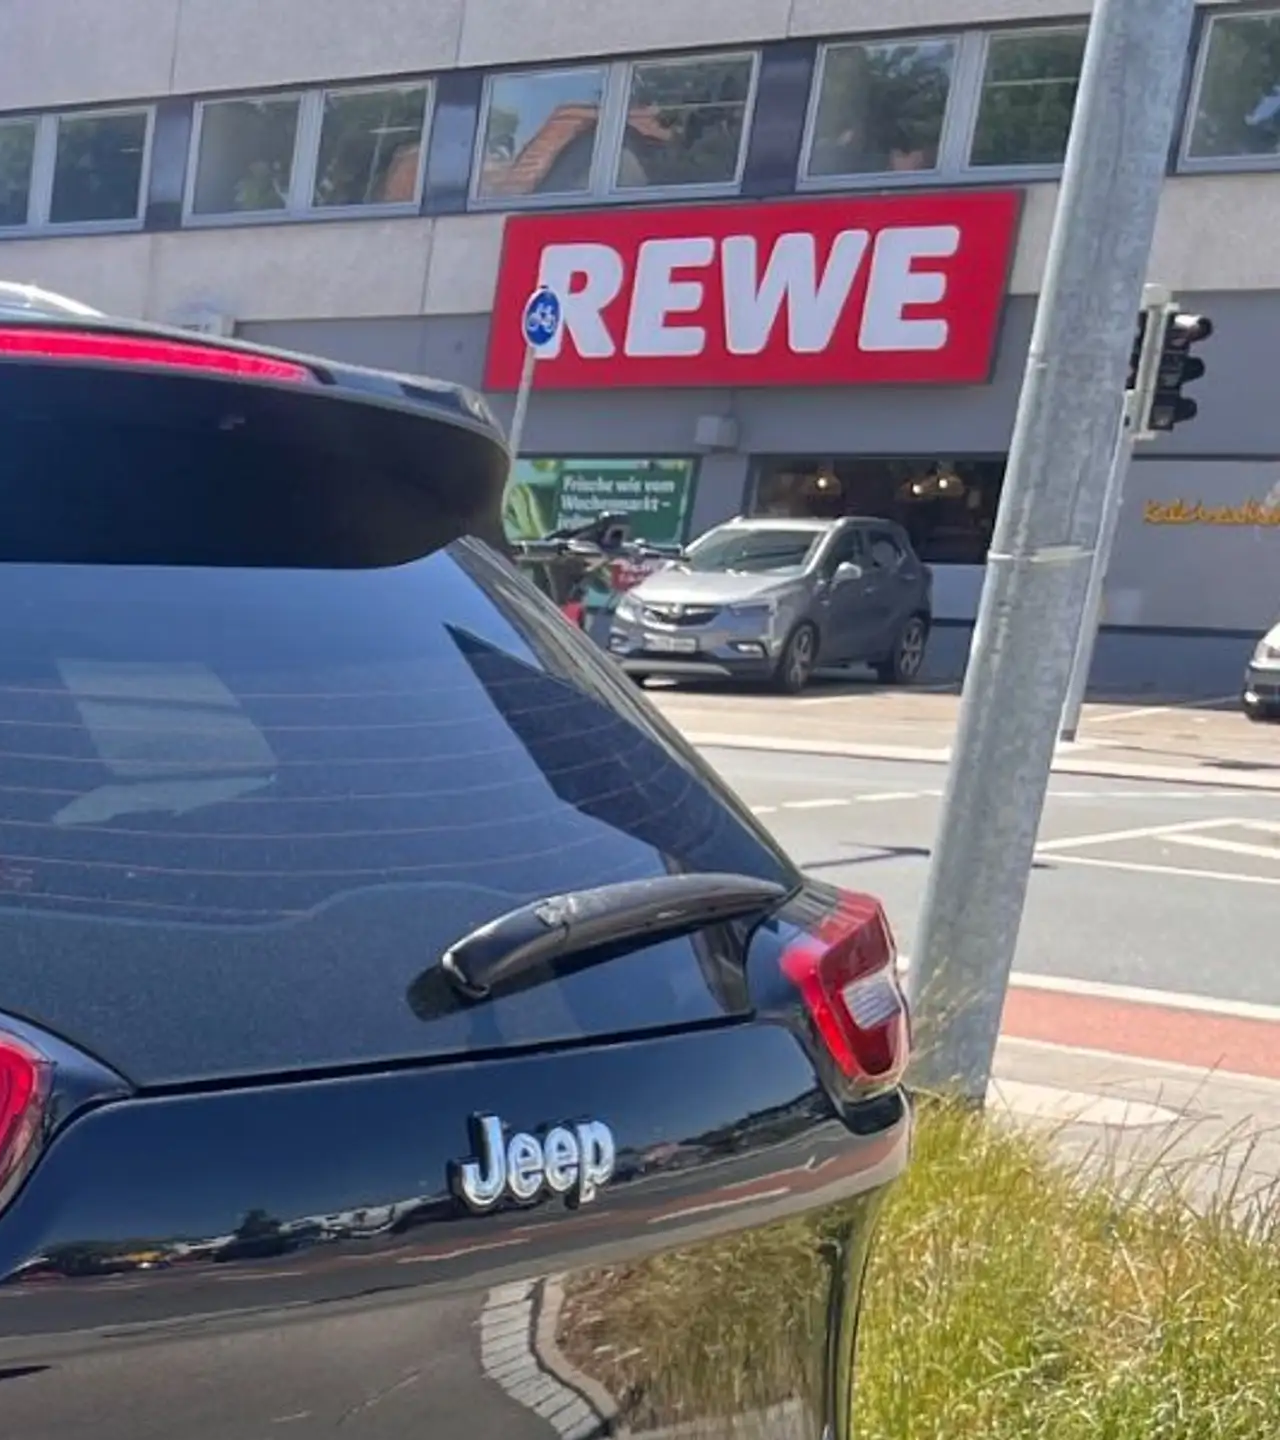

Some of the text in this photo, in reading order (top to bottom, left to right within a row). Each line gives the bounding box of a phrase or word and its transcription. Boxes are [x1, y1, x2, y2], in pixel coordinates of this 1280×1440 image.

[535, 225, 960, 357] REWE
[562, 474, 675, 492] Frische wie vom
[454, 1112, 616, 1207] Jeep
